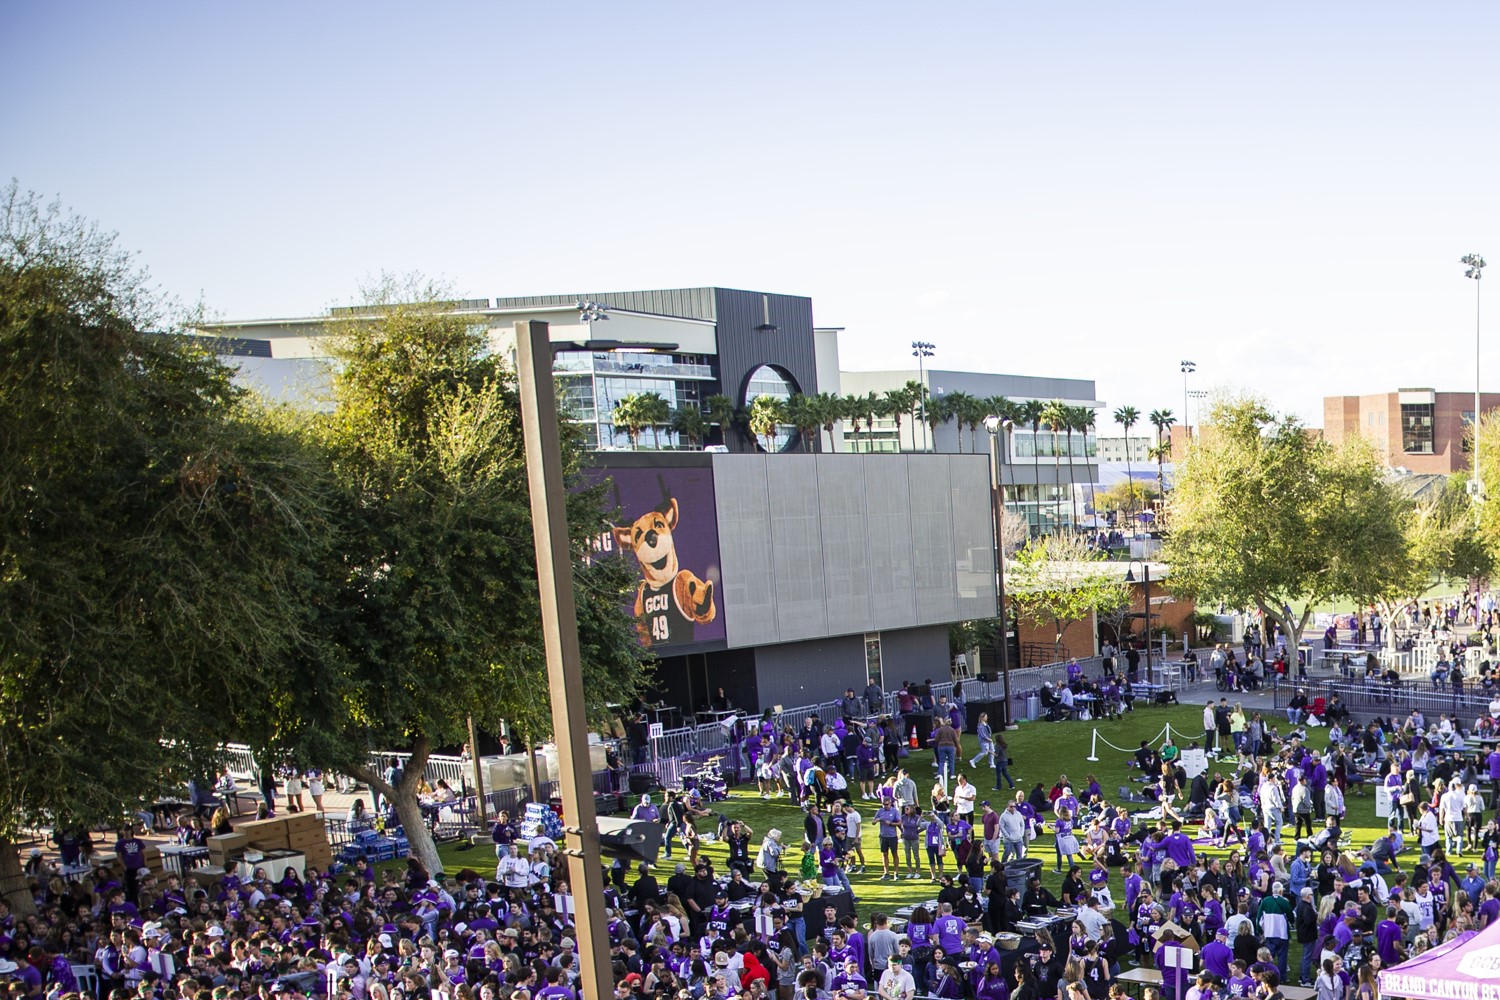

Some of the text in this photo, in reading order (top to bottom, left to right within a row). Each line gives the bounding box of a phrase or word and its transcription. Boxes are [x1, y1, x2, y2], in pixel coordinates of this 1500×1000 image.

[645, 594, 669, 614] GCU
[652, 615, 670, 640] 49
[1090, 967, 1099, 981] 4
[1384, 973, 1426, 995] GRAND
[1429, 979, 1479, 999] CANYON
